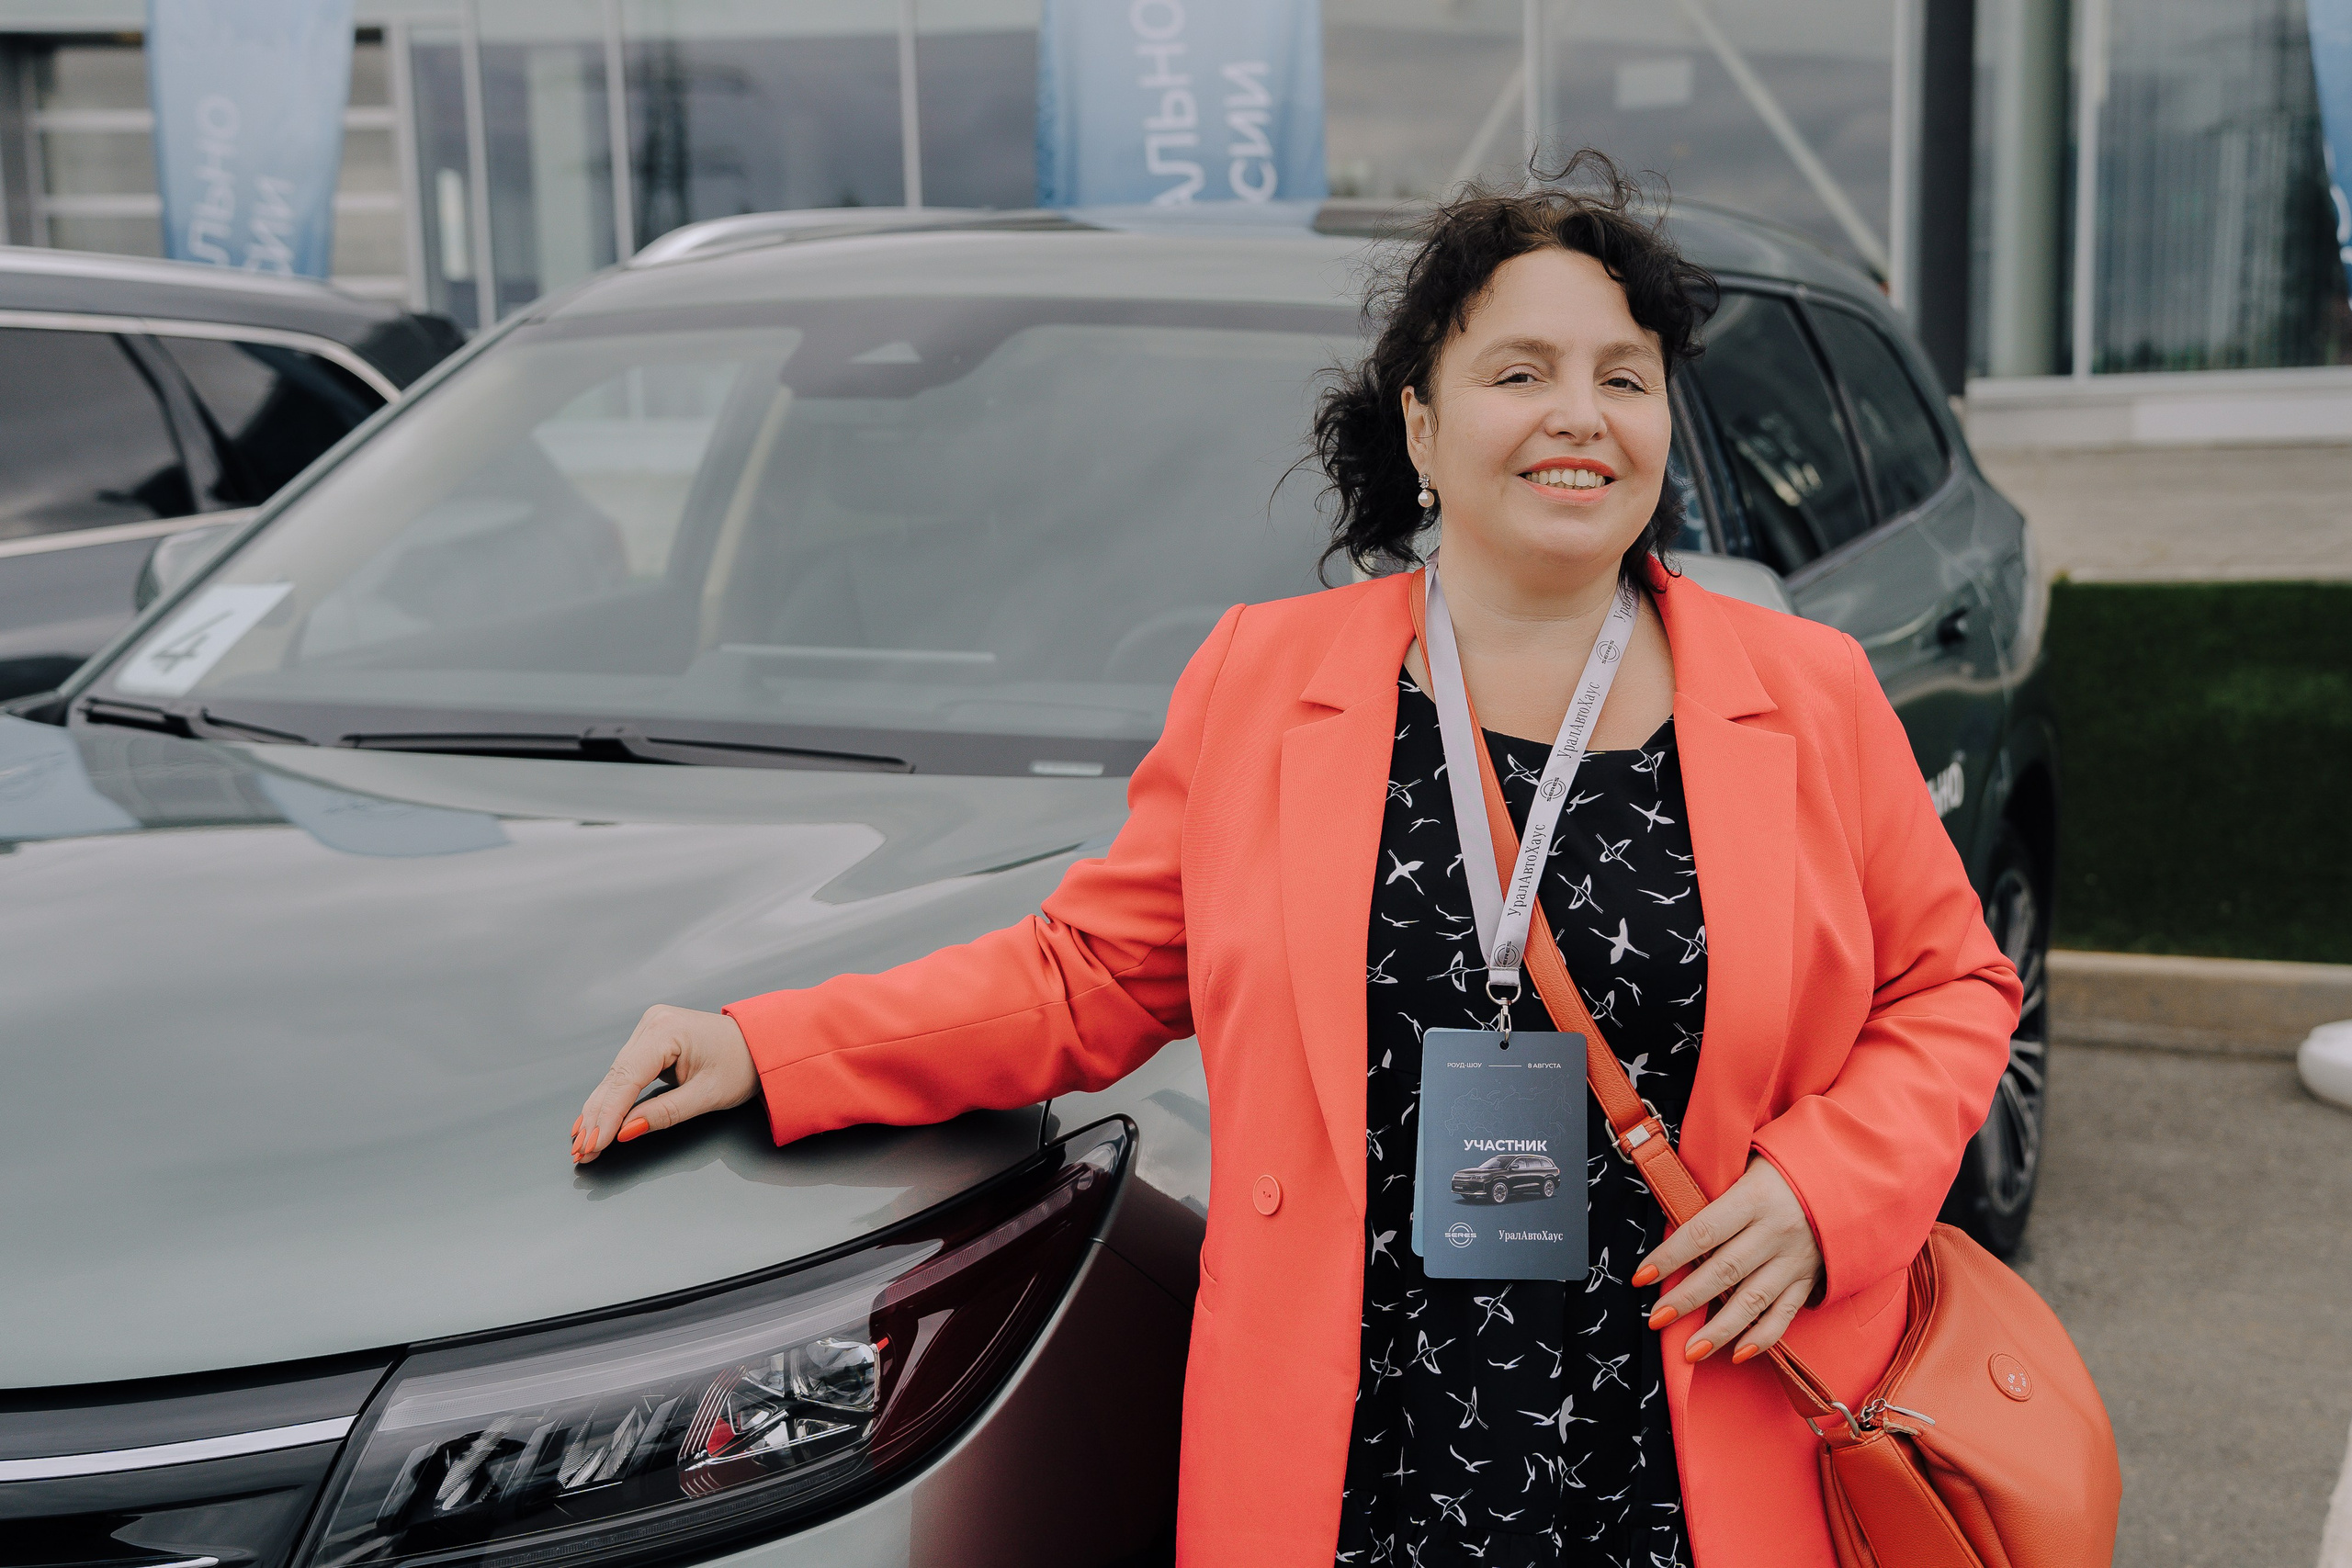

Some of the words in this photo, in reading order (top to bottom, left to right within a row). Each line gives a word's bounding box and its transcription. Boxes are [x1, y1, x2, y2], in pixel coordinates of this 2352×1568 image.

[1221, 61, 1278, 204] СИИ
[150, 608, 235, 676] 4
[1601, 639, 1615, 664] SERES
[1556, 682, 1601, 759] УралАвтоХаус
[1546, 776, 1560, 802] SERES
[1507, 824, 1546, 917] УралАвтоХаус
[1501, 940, 1513, 967] ERES
[1464, 1139, 1548, 1152] УЧАСТНИК
[1498, 1229, 1564, 1244] УралАвтоХаус
